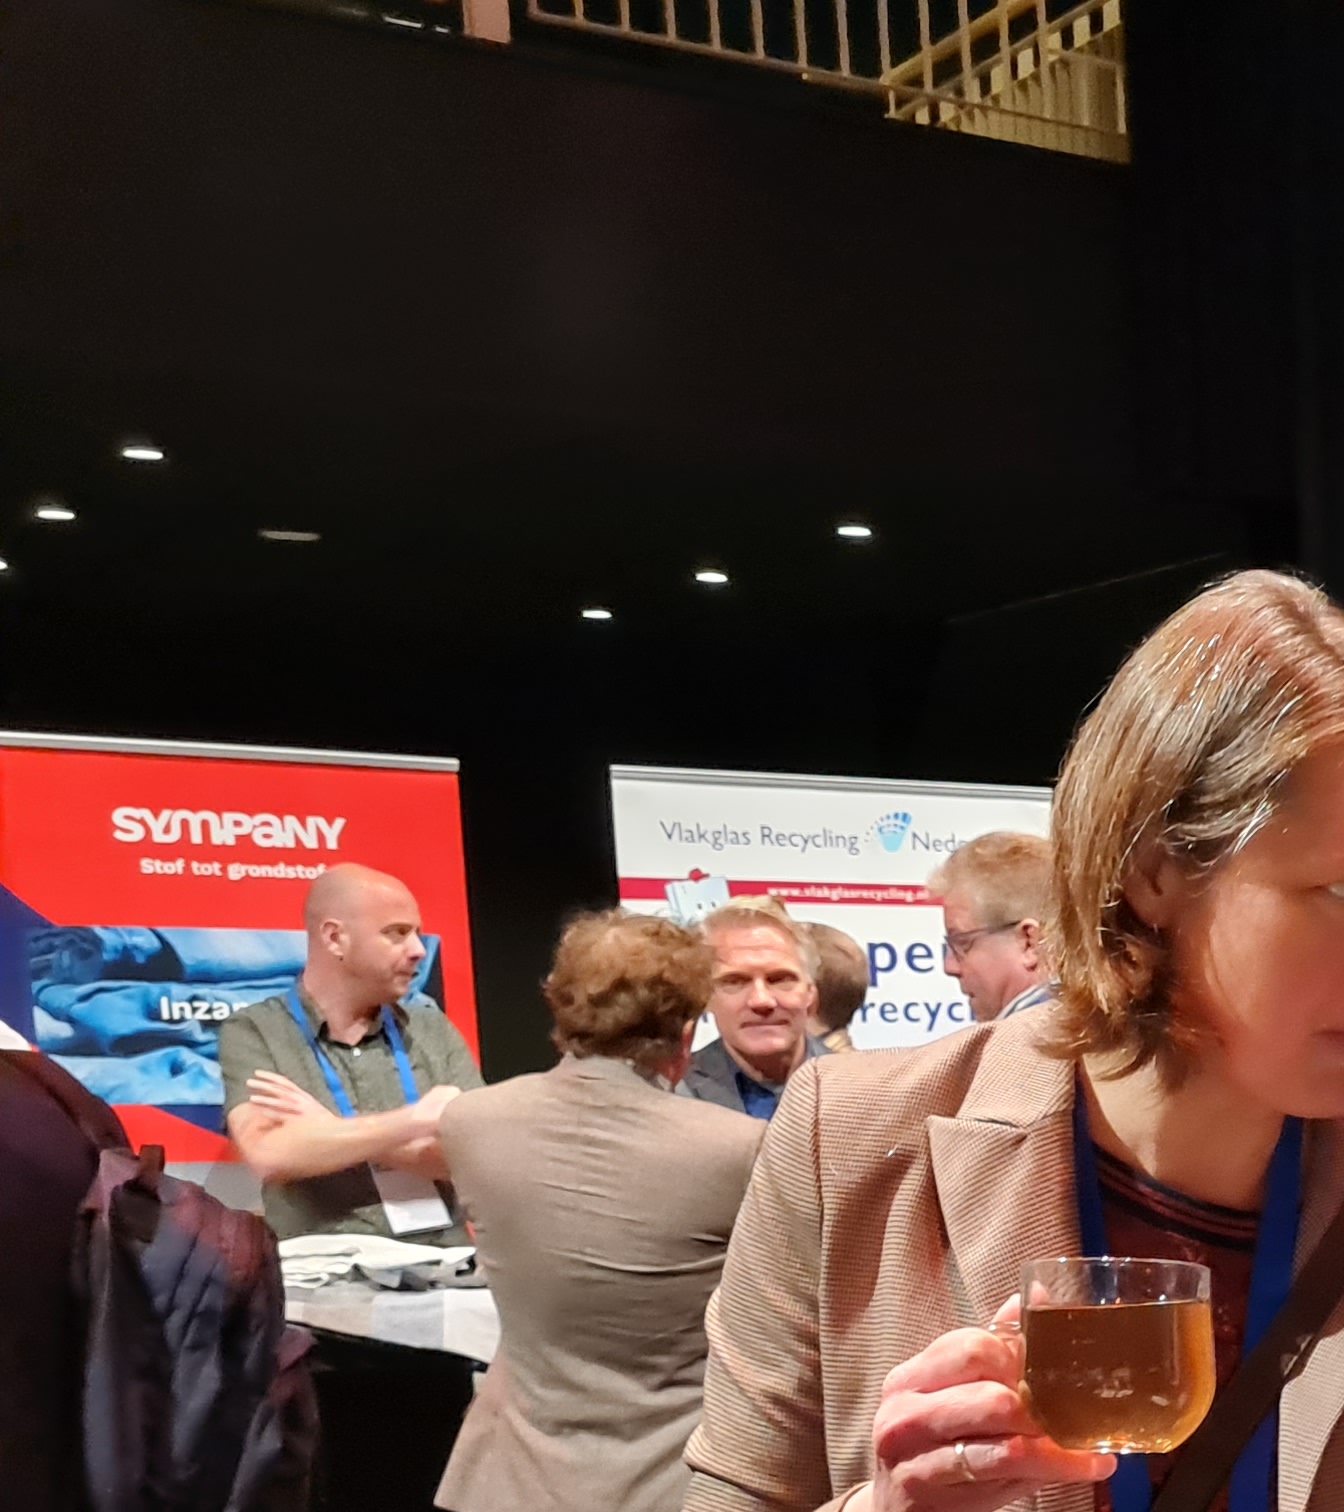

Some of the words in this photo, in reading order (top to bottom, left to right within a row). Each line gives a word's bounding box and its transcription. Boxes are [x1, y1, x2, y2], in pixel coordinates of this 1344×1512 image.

[659, 821, 751, 851] Vlakglas
[761, 826, 860, 856] Recycling
[139, 857, 185, 874] Stof
[191, 861, 223, 876] tot
